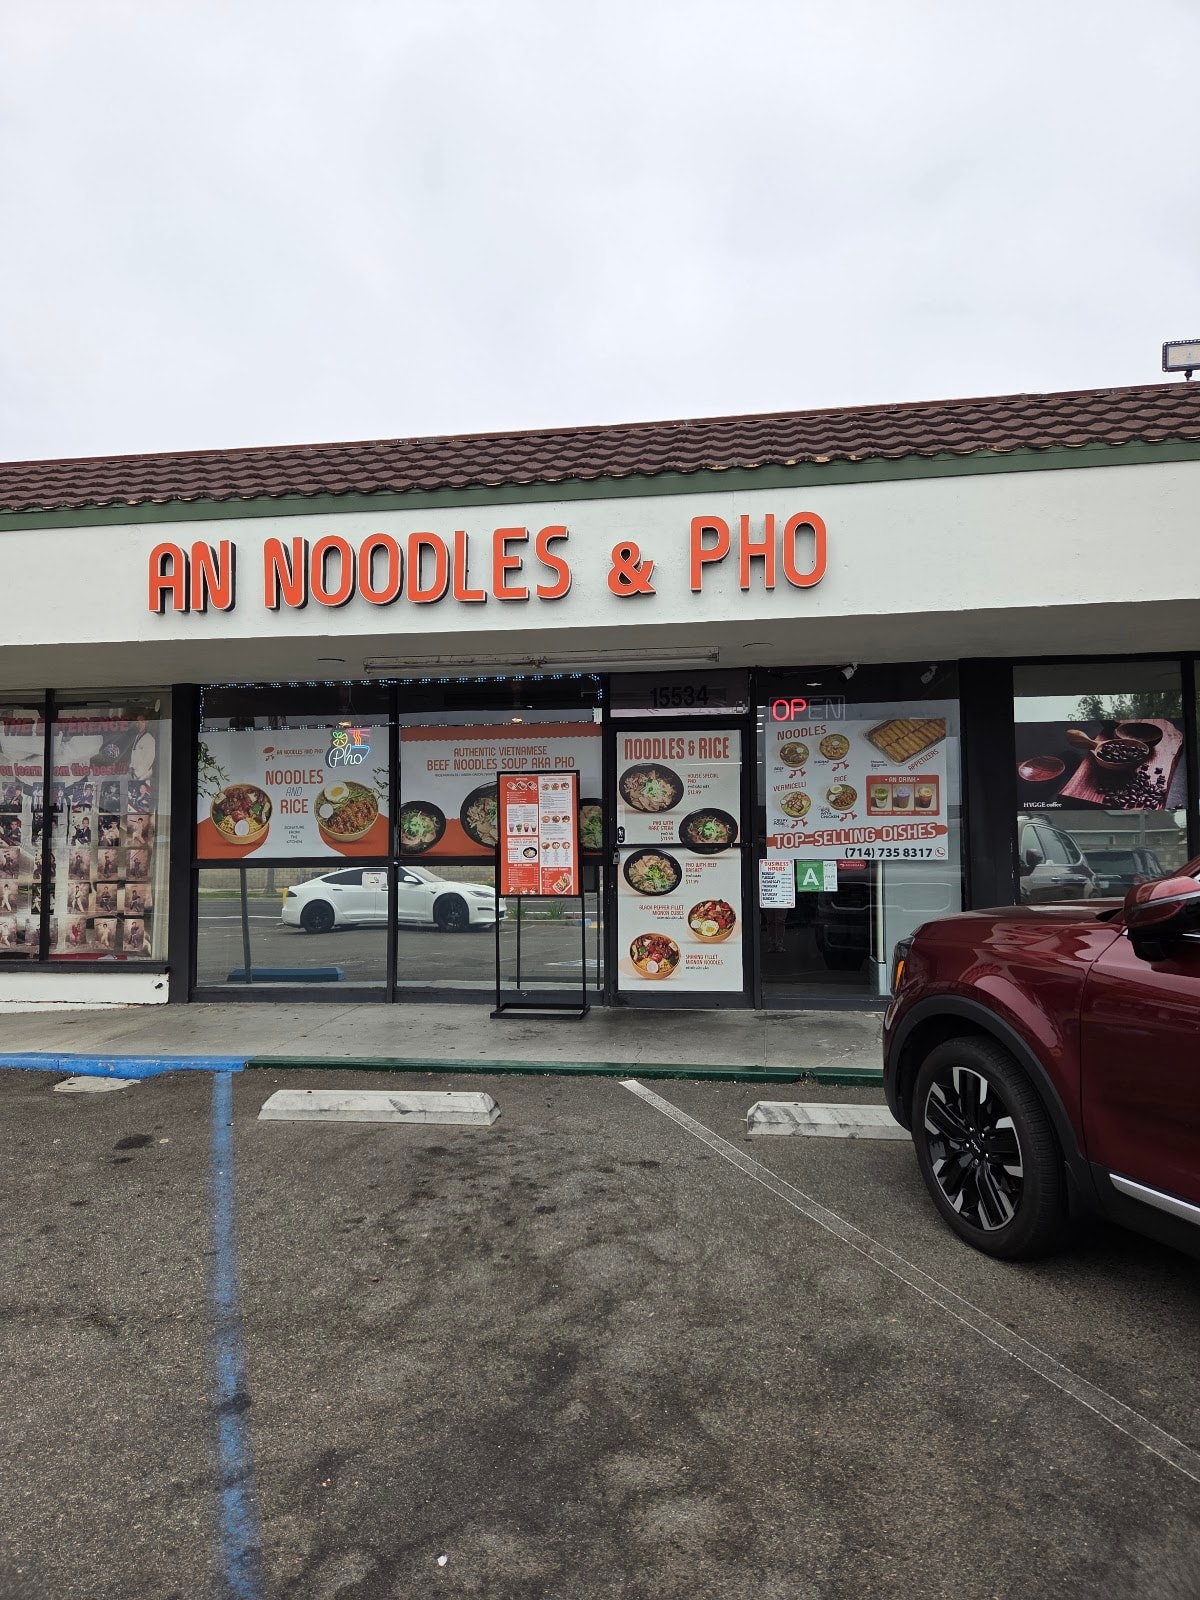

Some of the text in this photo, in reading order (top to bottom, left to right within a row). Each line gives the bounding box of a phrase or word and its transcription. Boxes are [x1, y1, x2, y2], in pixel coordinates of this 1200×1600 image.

[149, 511, 827, 613] AN NOODLES & PHO
[650, 684, 709, 707] 15534
[772, 698, 841, 721] OPEN
[777, 724, 827, 741] NOODLES
[329, 743, 363, 768] Pho
[454, 745, 548, 757] AUTHENTIC VIETNAMESE
[624, 737, 730, 760] NOODLES & RICE
[427, 756, 575, 771] BEEF NOODLES SOUP AKA PHO
[907, 749, 940, 772] APPETIZERS
[265, 769, 324, 785] NOODLES
[833, 774, 848, 783] RICE
[286, 787, 303, 797] AND
[773, 781, 807, 792] VERMICELLI
[280, 799, 309, 814] RICE
[774, 823, 936, 848] TOP-SELLING DISHES
[845, 847, 932, 859] (714) 735 8317
[802, 867, 820, 886] A
